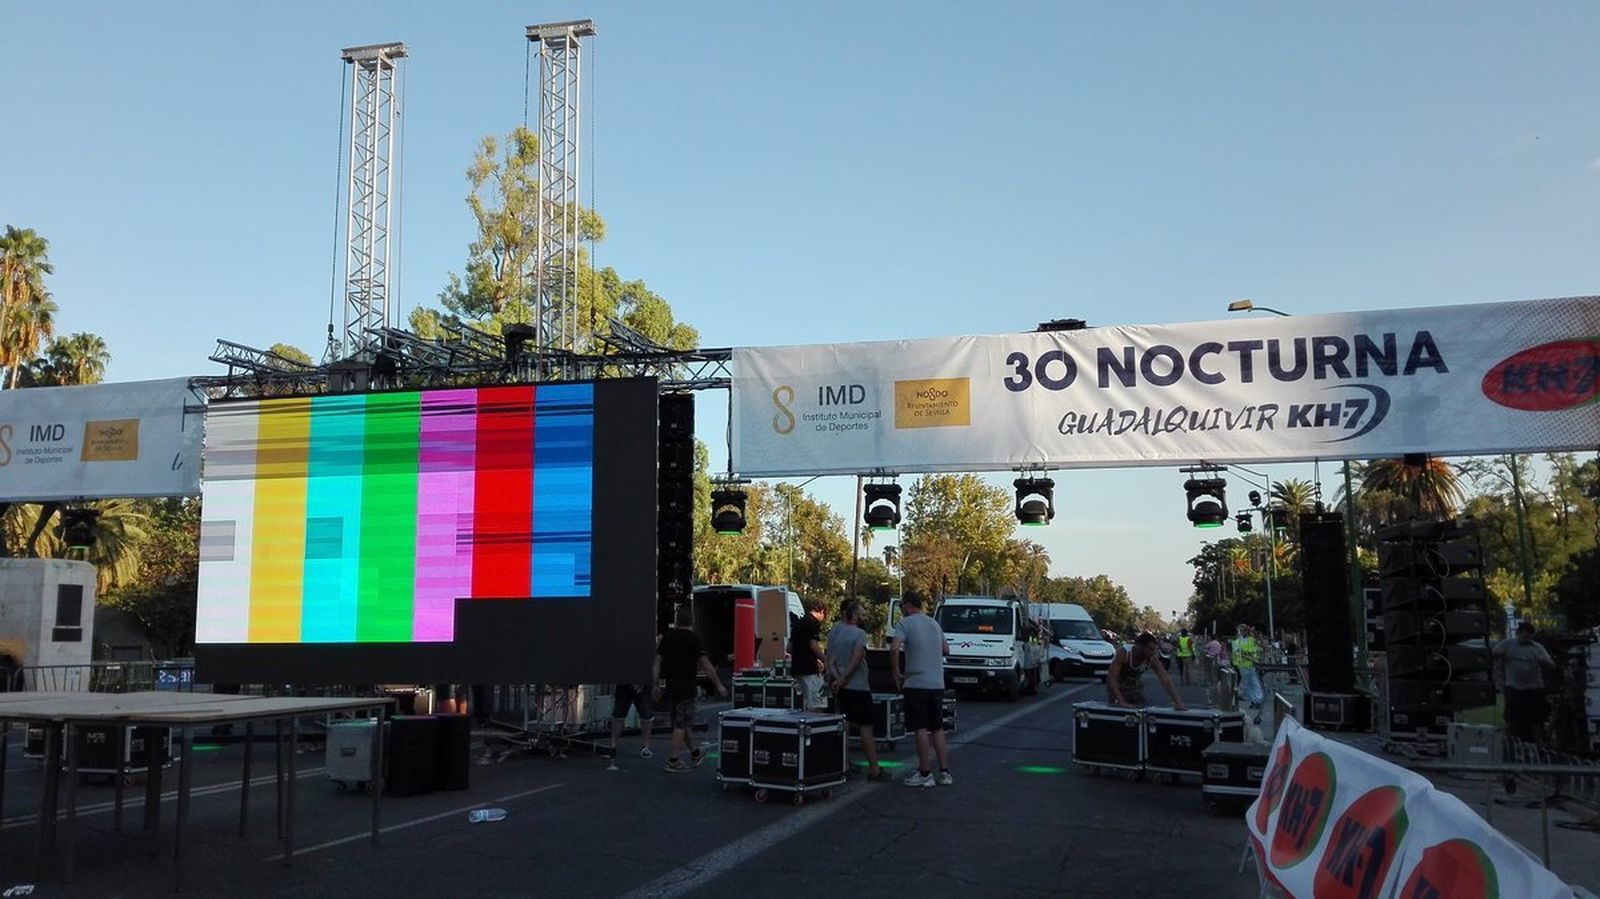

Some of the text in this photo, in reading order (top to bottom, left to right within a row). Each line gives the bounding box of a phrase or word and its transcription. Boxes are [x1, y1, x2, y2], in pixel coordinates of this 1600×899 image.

[1003, 330, 1450, 392] 30 NOCTURNA
[818, 384, 866, 406] IMD
[802, 410, 882, 421] Instituto Municipal
[1057, 403, 1279, 437] GUADALQUIVIR
[30, 423, 65, 442] IMD
[815, 422, 869, 432] de Deportes
